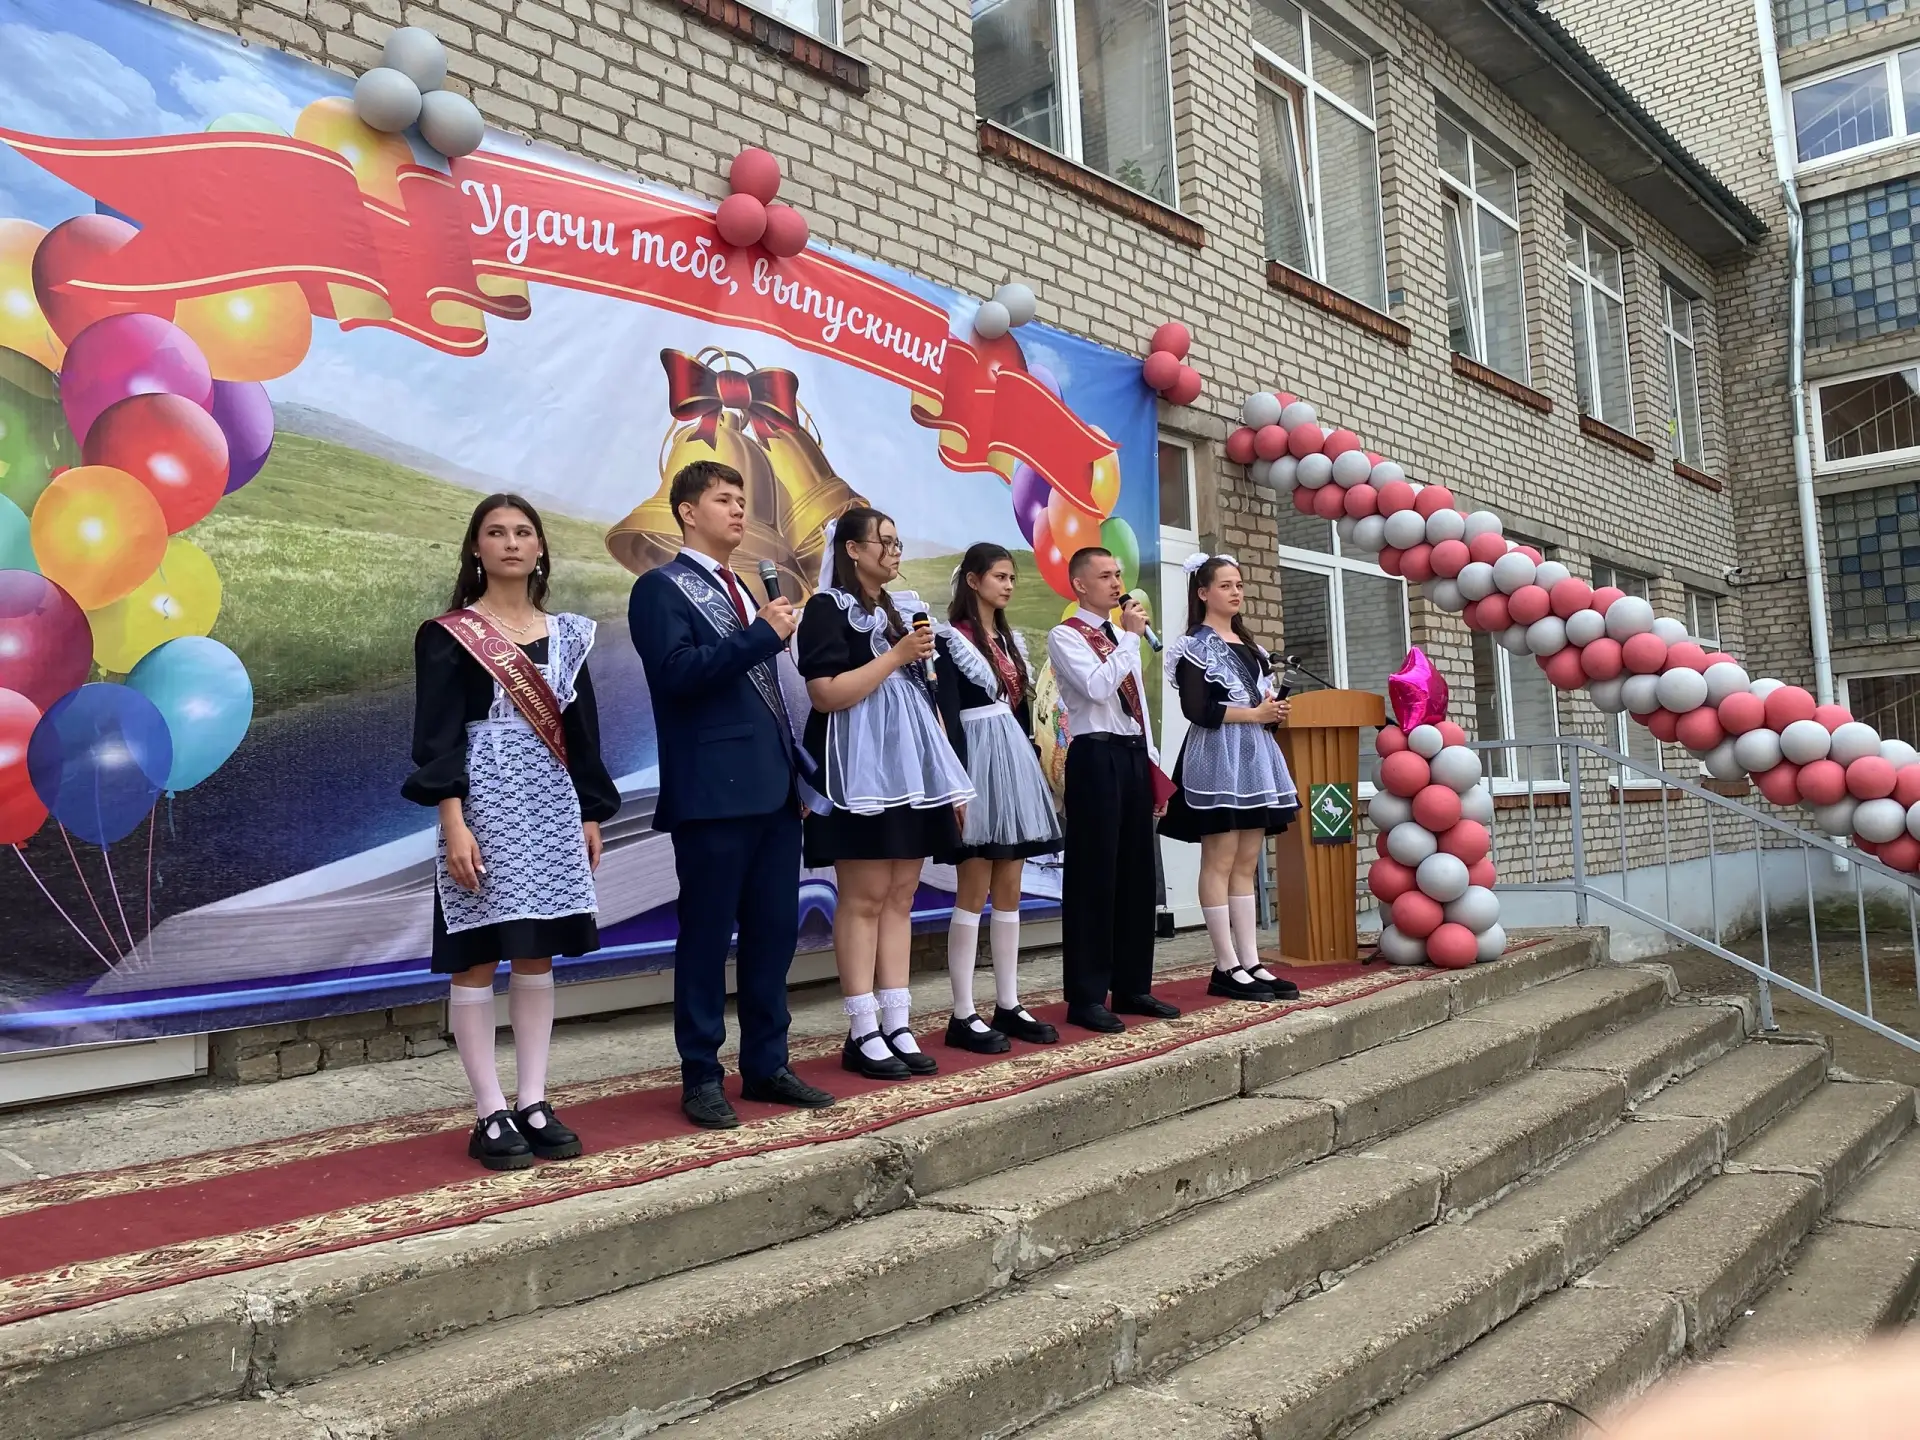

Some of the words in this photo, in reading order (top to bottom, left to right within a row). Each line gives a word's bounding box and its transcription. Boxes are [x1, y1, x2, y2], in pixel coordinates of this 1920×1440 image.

[460, 179, 620, 265] Удачи
[631, 228, 739, 296] тебе,
[751, 257, 948, 375] выпускник!
[483, 637, 558, 730] Выпускница
